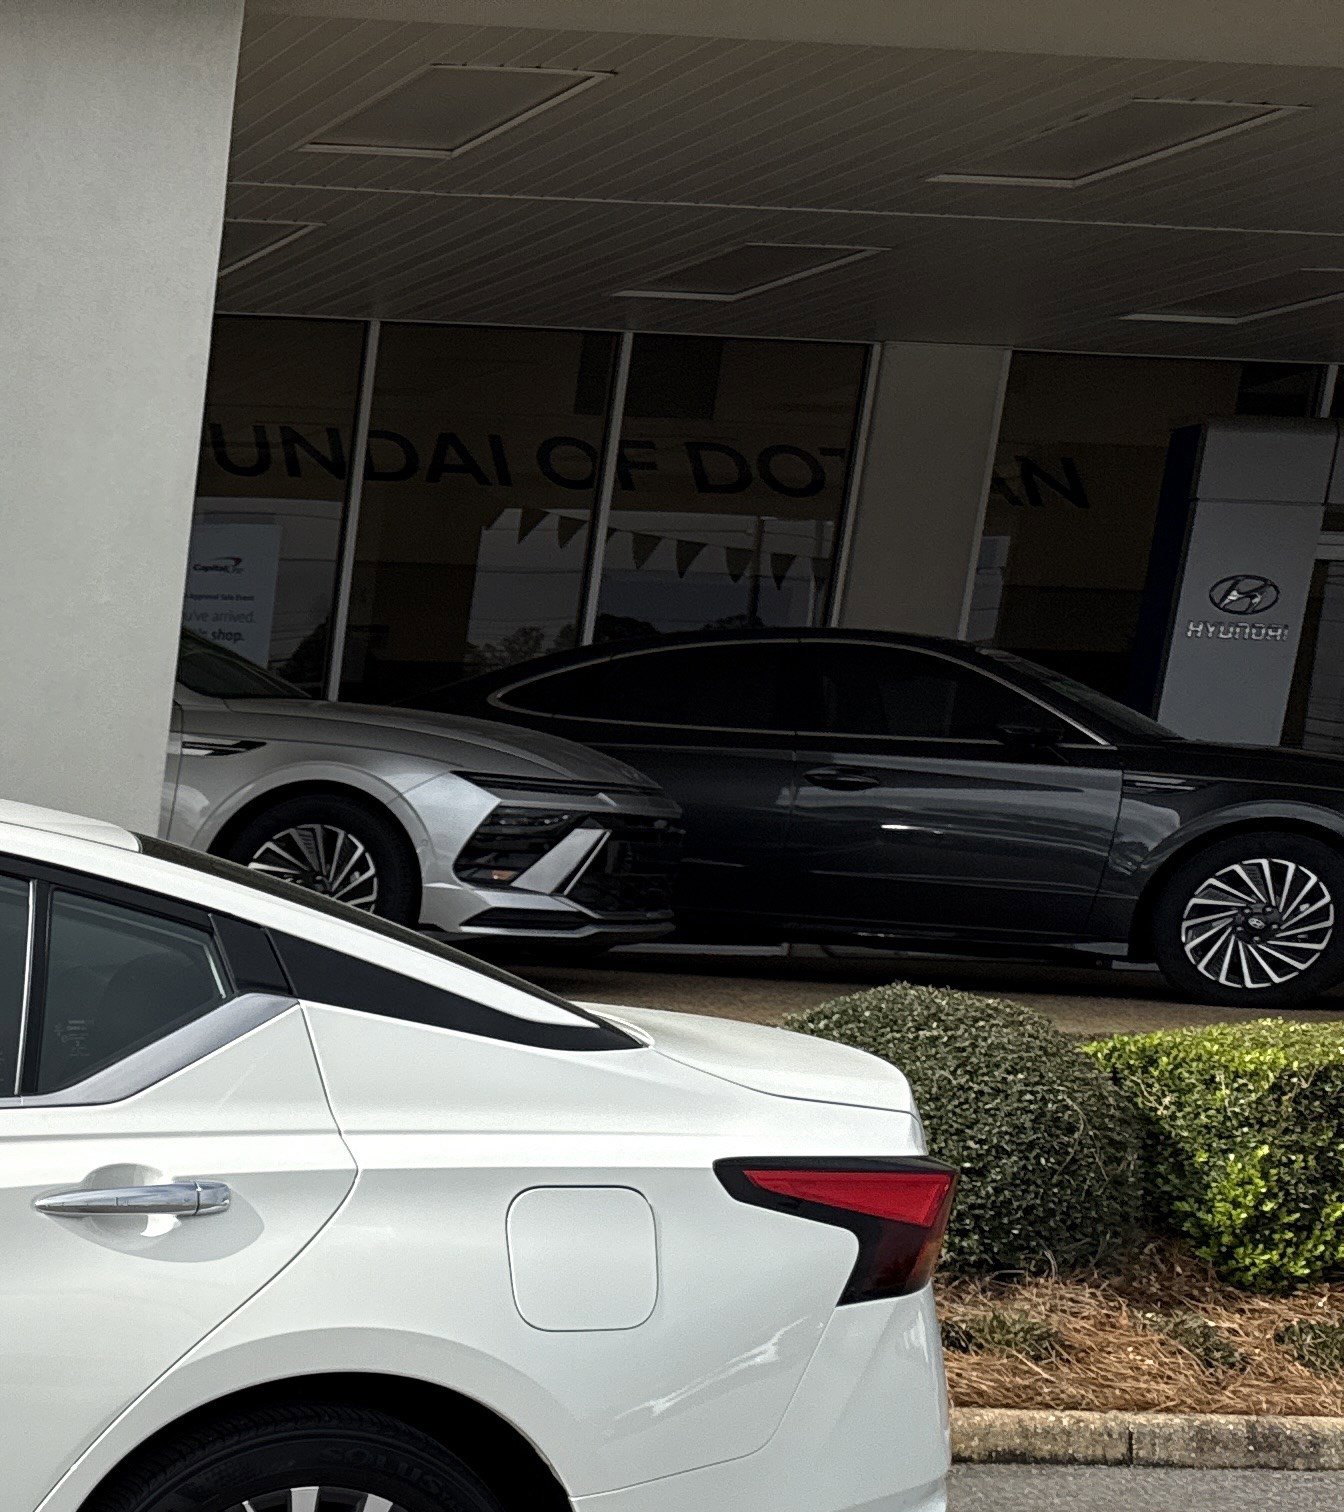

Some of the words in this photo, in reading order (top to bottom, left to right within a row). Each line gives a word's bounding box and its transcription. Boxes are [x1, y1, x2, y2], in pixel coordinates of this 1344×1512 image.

[207, 423, 520, 487] UNDAI
[536, 434, 657, 493] OF
[1186, 620, 1290, 641] HYUNDAI
